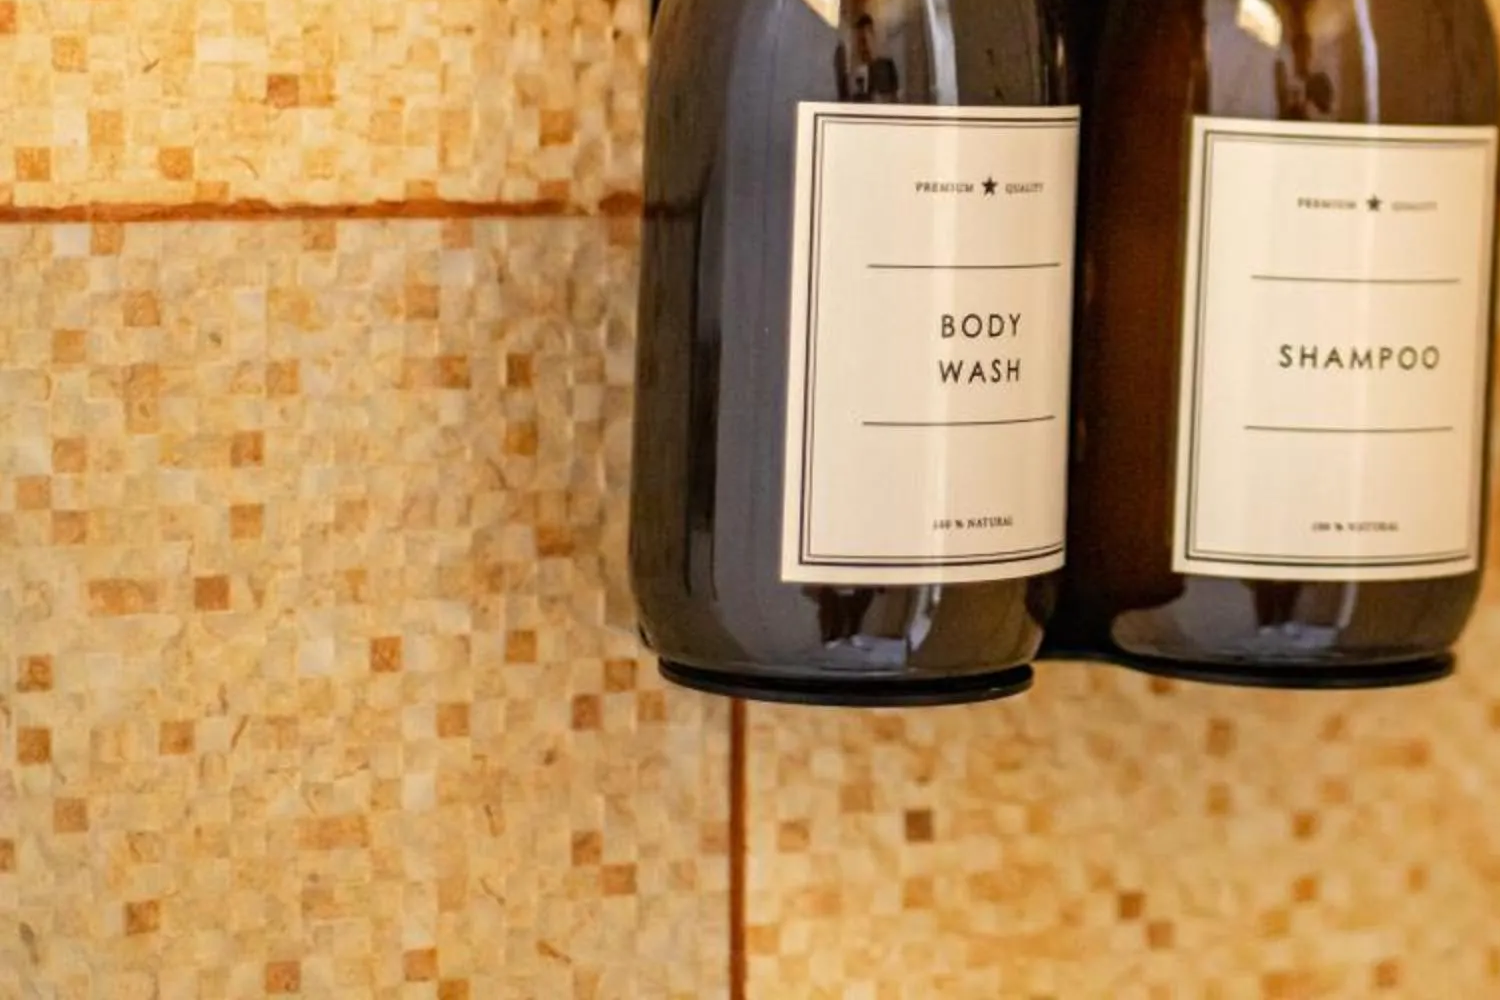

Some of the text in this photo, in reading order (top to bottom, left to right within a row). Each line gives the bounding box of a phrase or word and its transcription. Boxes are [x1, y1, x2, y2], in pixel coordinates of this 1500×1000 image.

[915, 182, 1044, 194] PREMIUM QUALITY
[941, 313, 1021, 338] BODY
[1279, 344, 1440, 370] SHAMPOO
[939, 358, 1020, 383] WASH
[967, 515, 1013, 528] NATURAL
